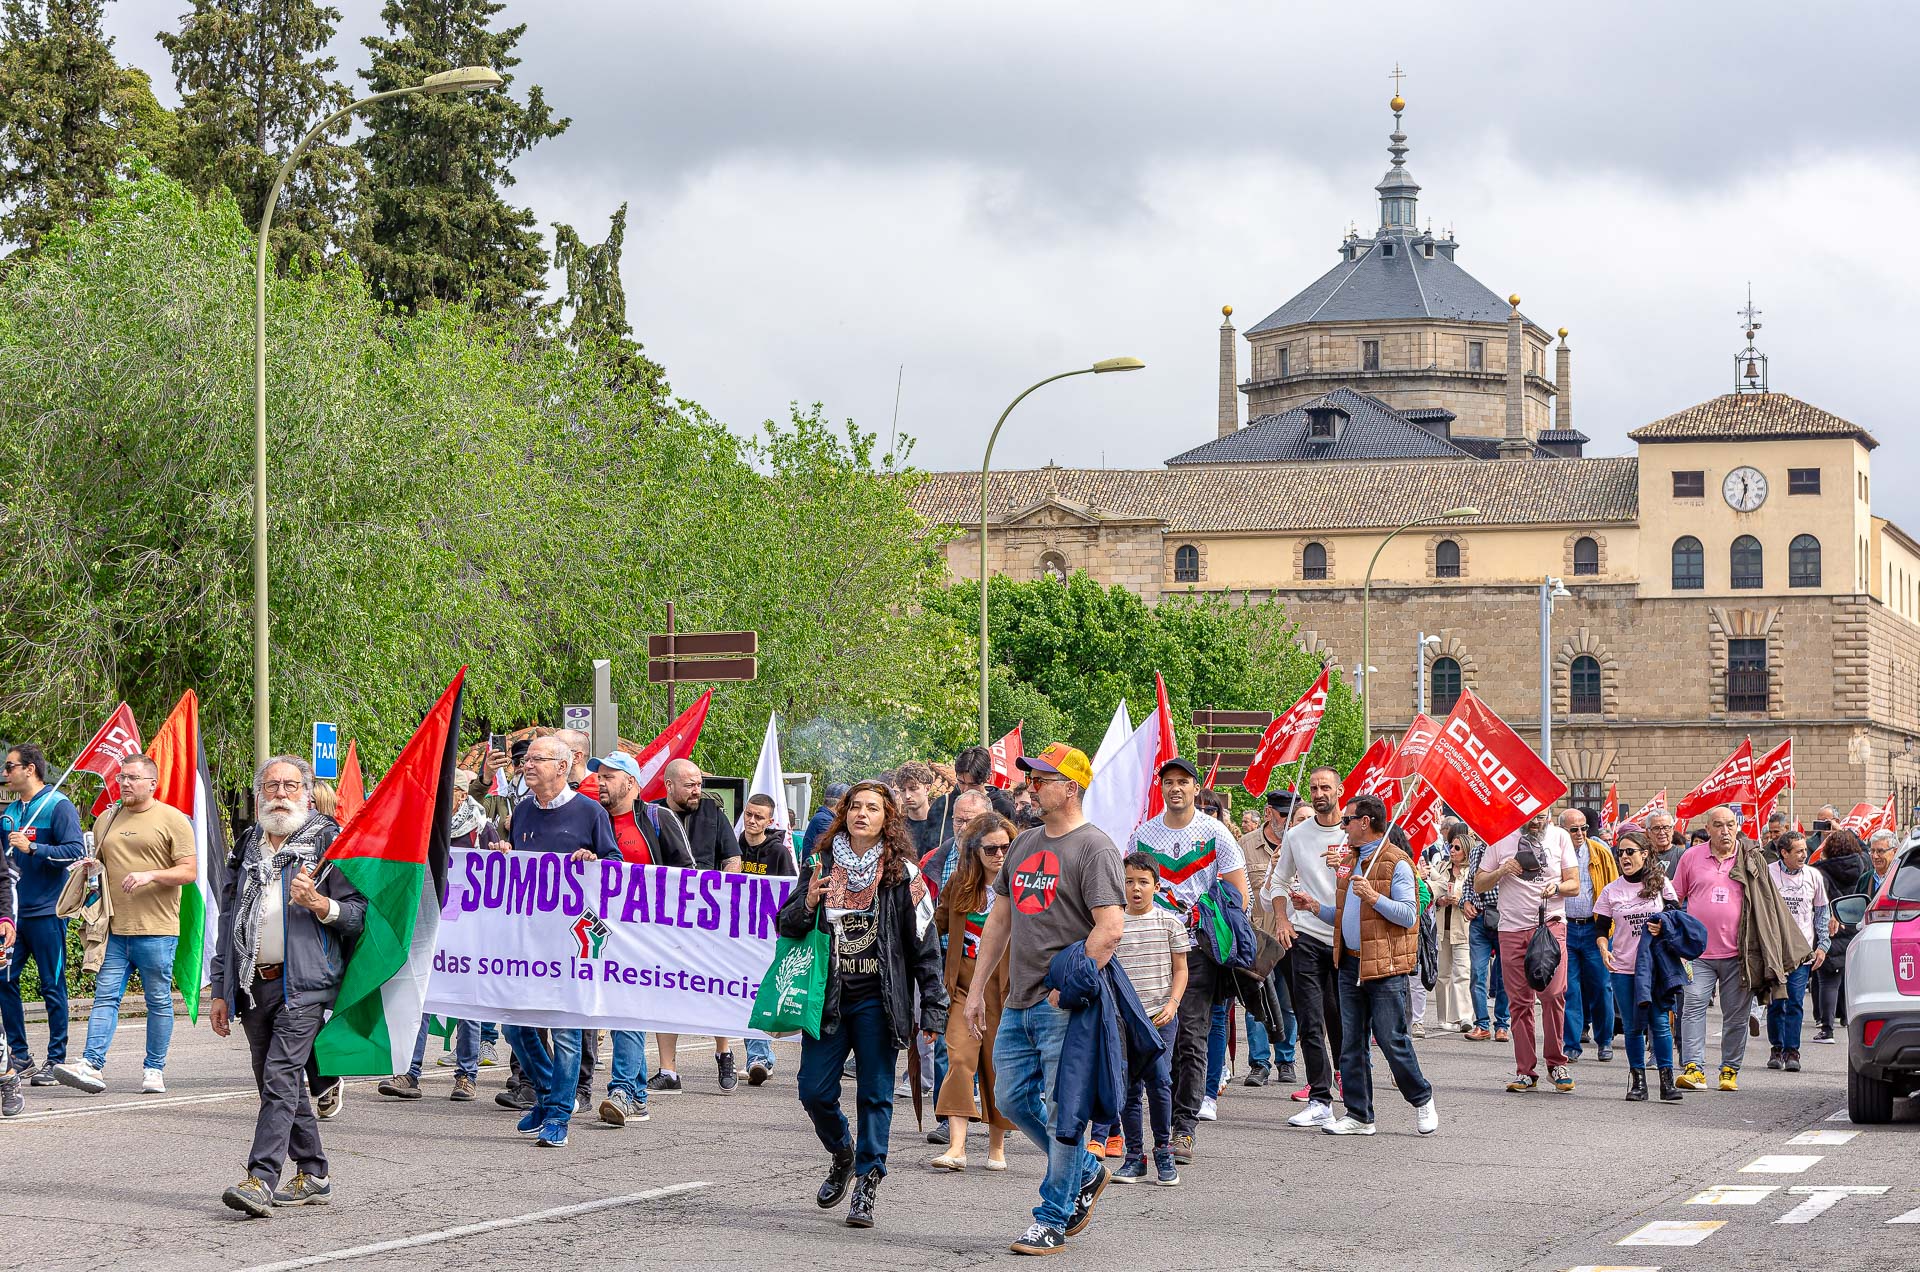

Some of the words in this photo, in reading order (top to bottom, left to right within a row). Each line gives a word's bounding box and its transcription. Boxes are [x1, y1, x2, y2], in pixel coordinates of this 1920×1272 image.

[570, 720, 586, 729] 10
[575, 708, 583, 718] 5
[316, 742, 336, 759] TAXI
[1434, 744, 1443, 754] de
[1468, 780, 1491, 806] Mancha
[1439, 738, 1472, 771] Comisiones
[1470, 770, 1492, 796] Obreras
[1446, 717, 1517, 793] CCOO
[461, 851, 584, 916] SOMOS
[1014, 874, 1055, 890] CLASH
[433, 950, 471, 973] das
[478, 957, 561, 978] somos
[570, 956, 593, 980] la
[603, 960, 760, 1000] Resistencia
